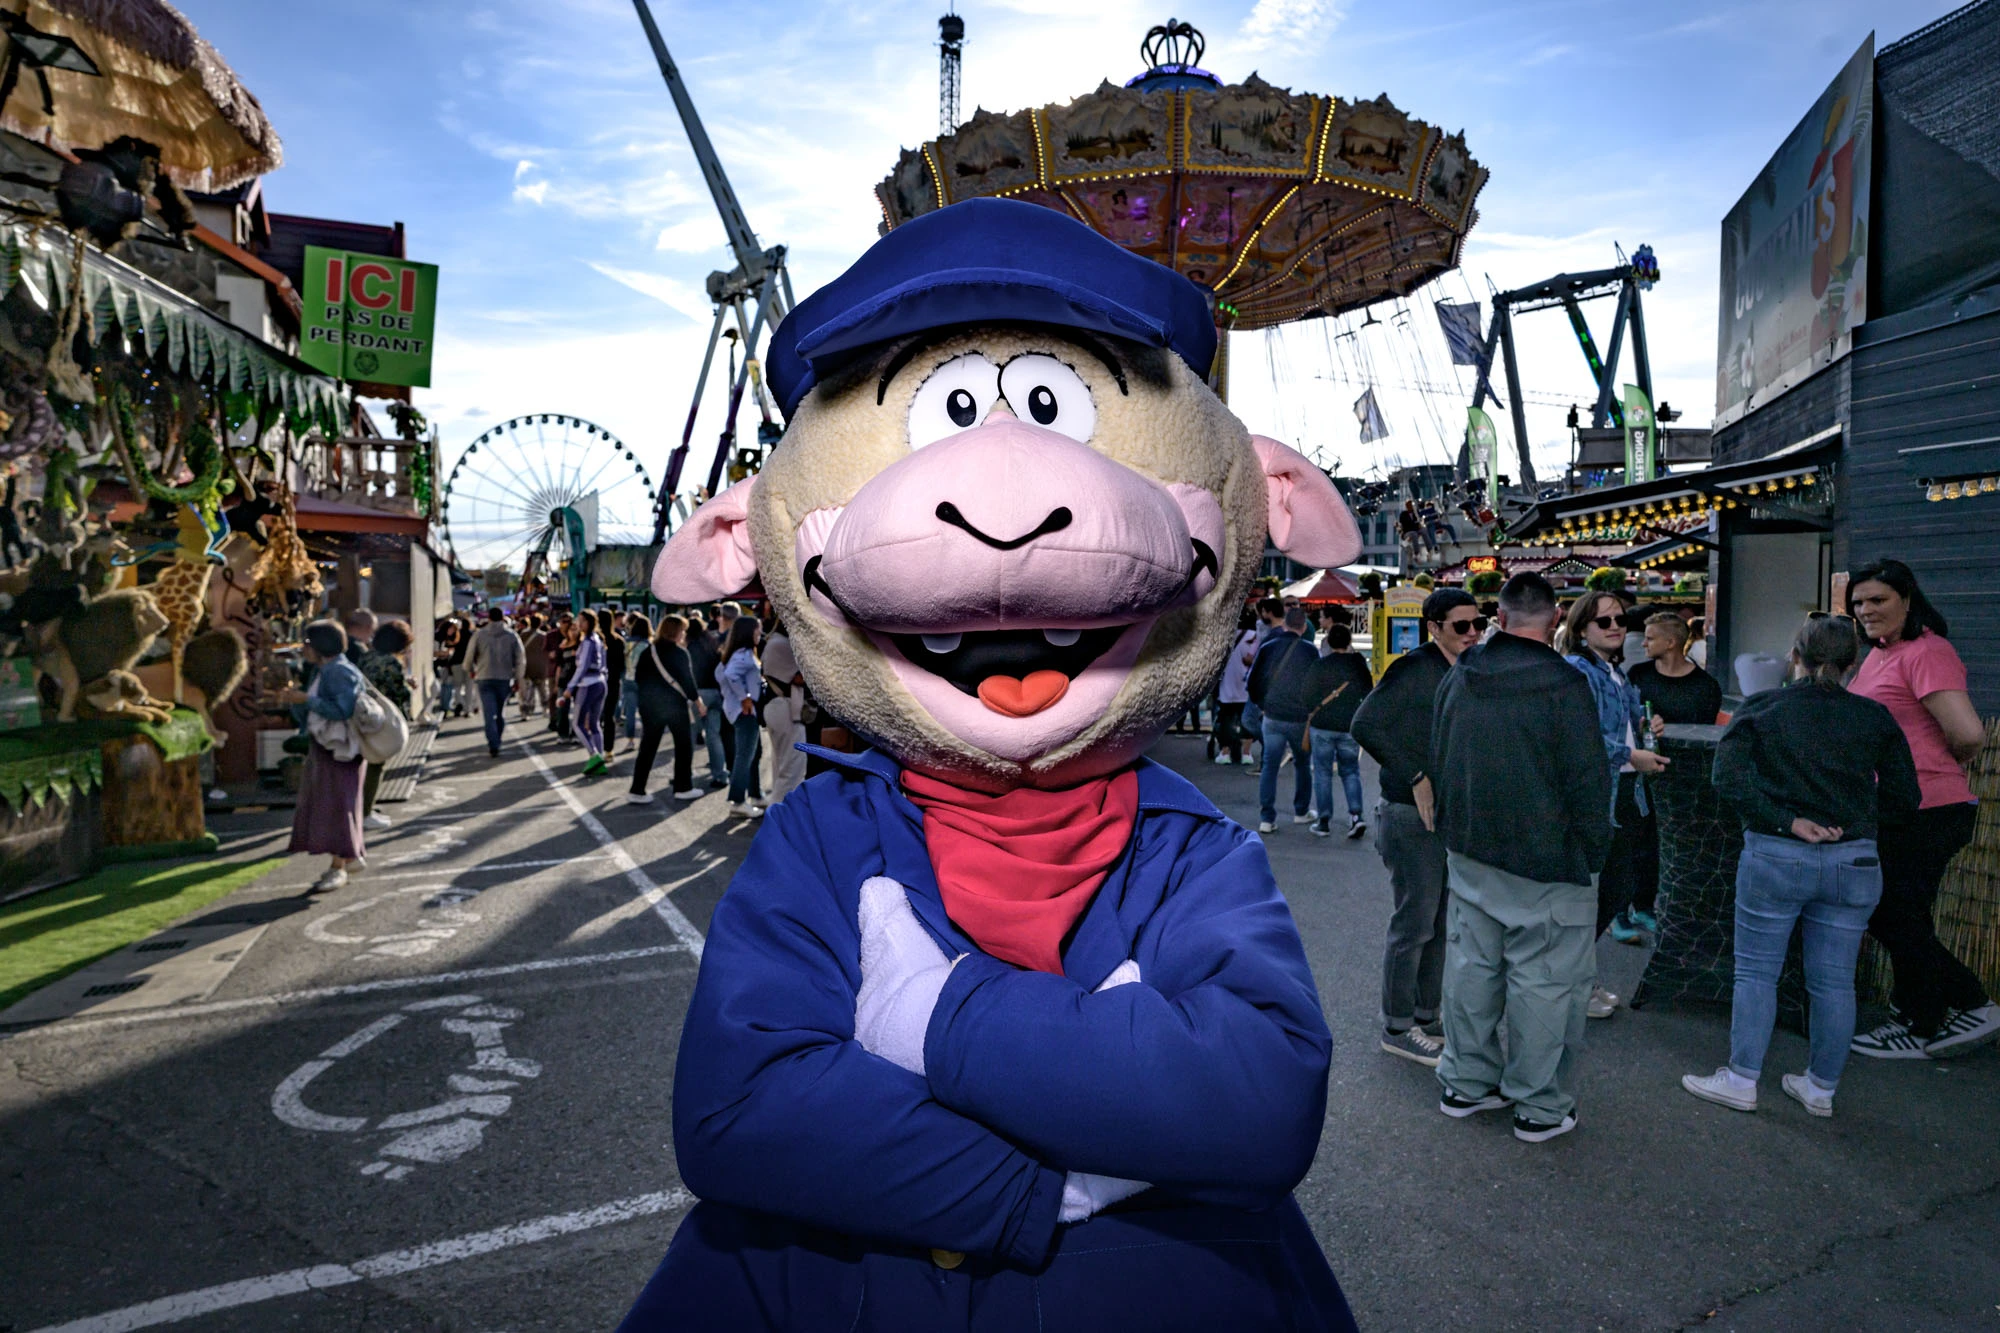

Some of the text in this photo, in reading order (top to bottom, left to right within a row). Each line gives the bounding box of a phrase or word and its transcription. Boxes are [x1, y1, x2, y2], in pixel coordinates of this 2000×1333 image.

[326, 258, 416, 313] ICI
[326, 307, 411, 331] PAS DE
[310, 327, 423, 354] PERDANT
